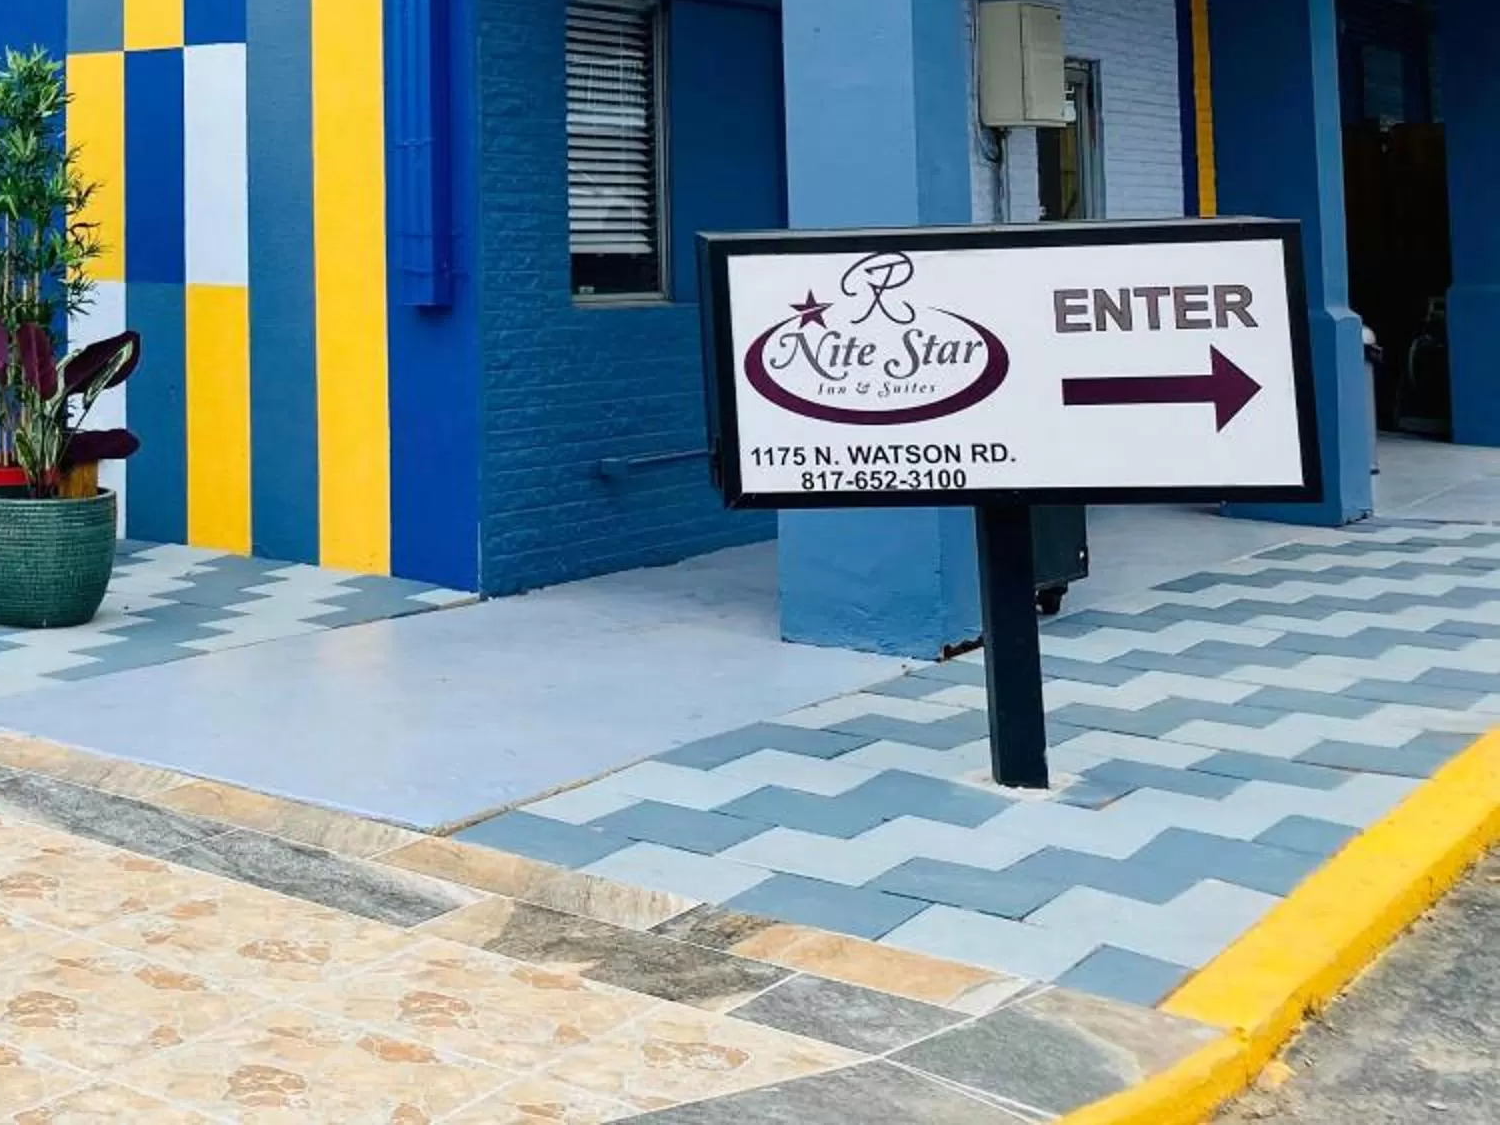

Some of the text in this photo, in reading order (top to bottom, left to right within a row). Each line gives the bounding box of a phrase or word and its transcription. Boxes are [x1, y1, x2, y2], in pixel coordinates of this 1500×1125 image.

[1053, 284, 1259, 333] ENTER
[769, 328, 982, 381] Nite Star
[817, 379, 936, 399] Inn & Suites
[750, 442, 1017, 466] 1175 N. WATSON RD.
[801, 469, 967, 490] 817-652-3100
